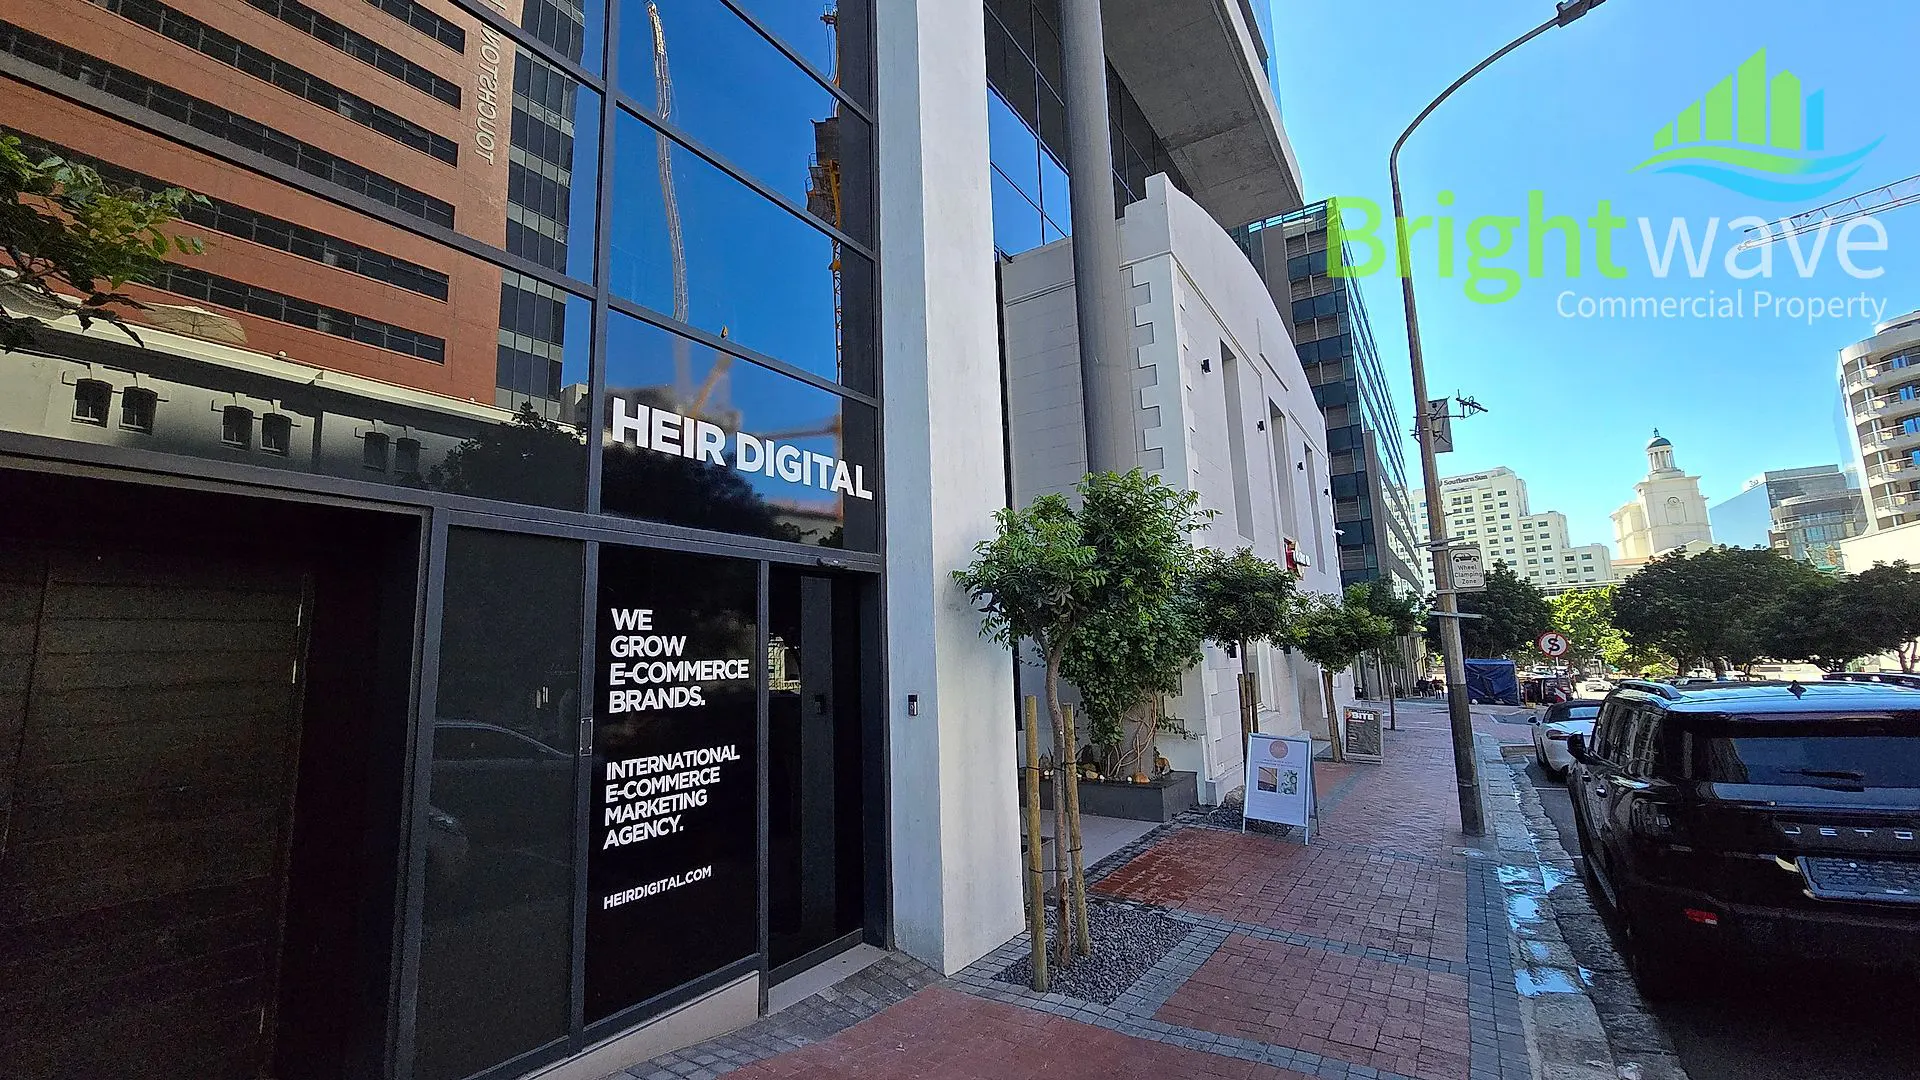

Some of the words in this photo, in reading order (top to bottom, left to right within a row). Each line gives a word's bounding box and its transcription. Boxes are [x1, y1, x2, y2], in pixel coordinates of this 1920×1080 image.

[612, 397, 727, 467] HEIR
[737, 432, 872, 500] DIGITAL
[1444, 477, 1475, 485] Southern
[1475, 475, 1488, 483] Sun
[611, 608, 653, 631] WE
[610, 635, 686, 657] GROW
[610, 659, 749, 685] E-COMMERCE
[609, 686, 706, 713] BRANDS.
[1352, 712, 1374, 720] BITE
[606, 745, 740, 781] INTERNATIONAL
[605, 767, 720, 803] E-COMMERCE
[604, 789, 708, 826] MARKETING
[603, 816, 684, 850] AGENCY.
[1784, 826, 1914, 840] JETO
[603, 865, 712, 909] HEIRDIGITAL.COM
